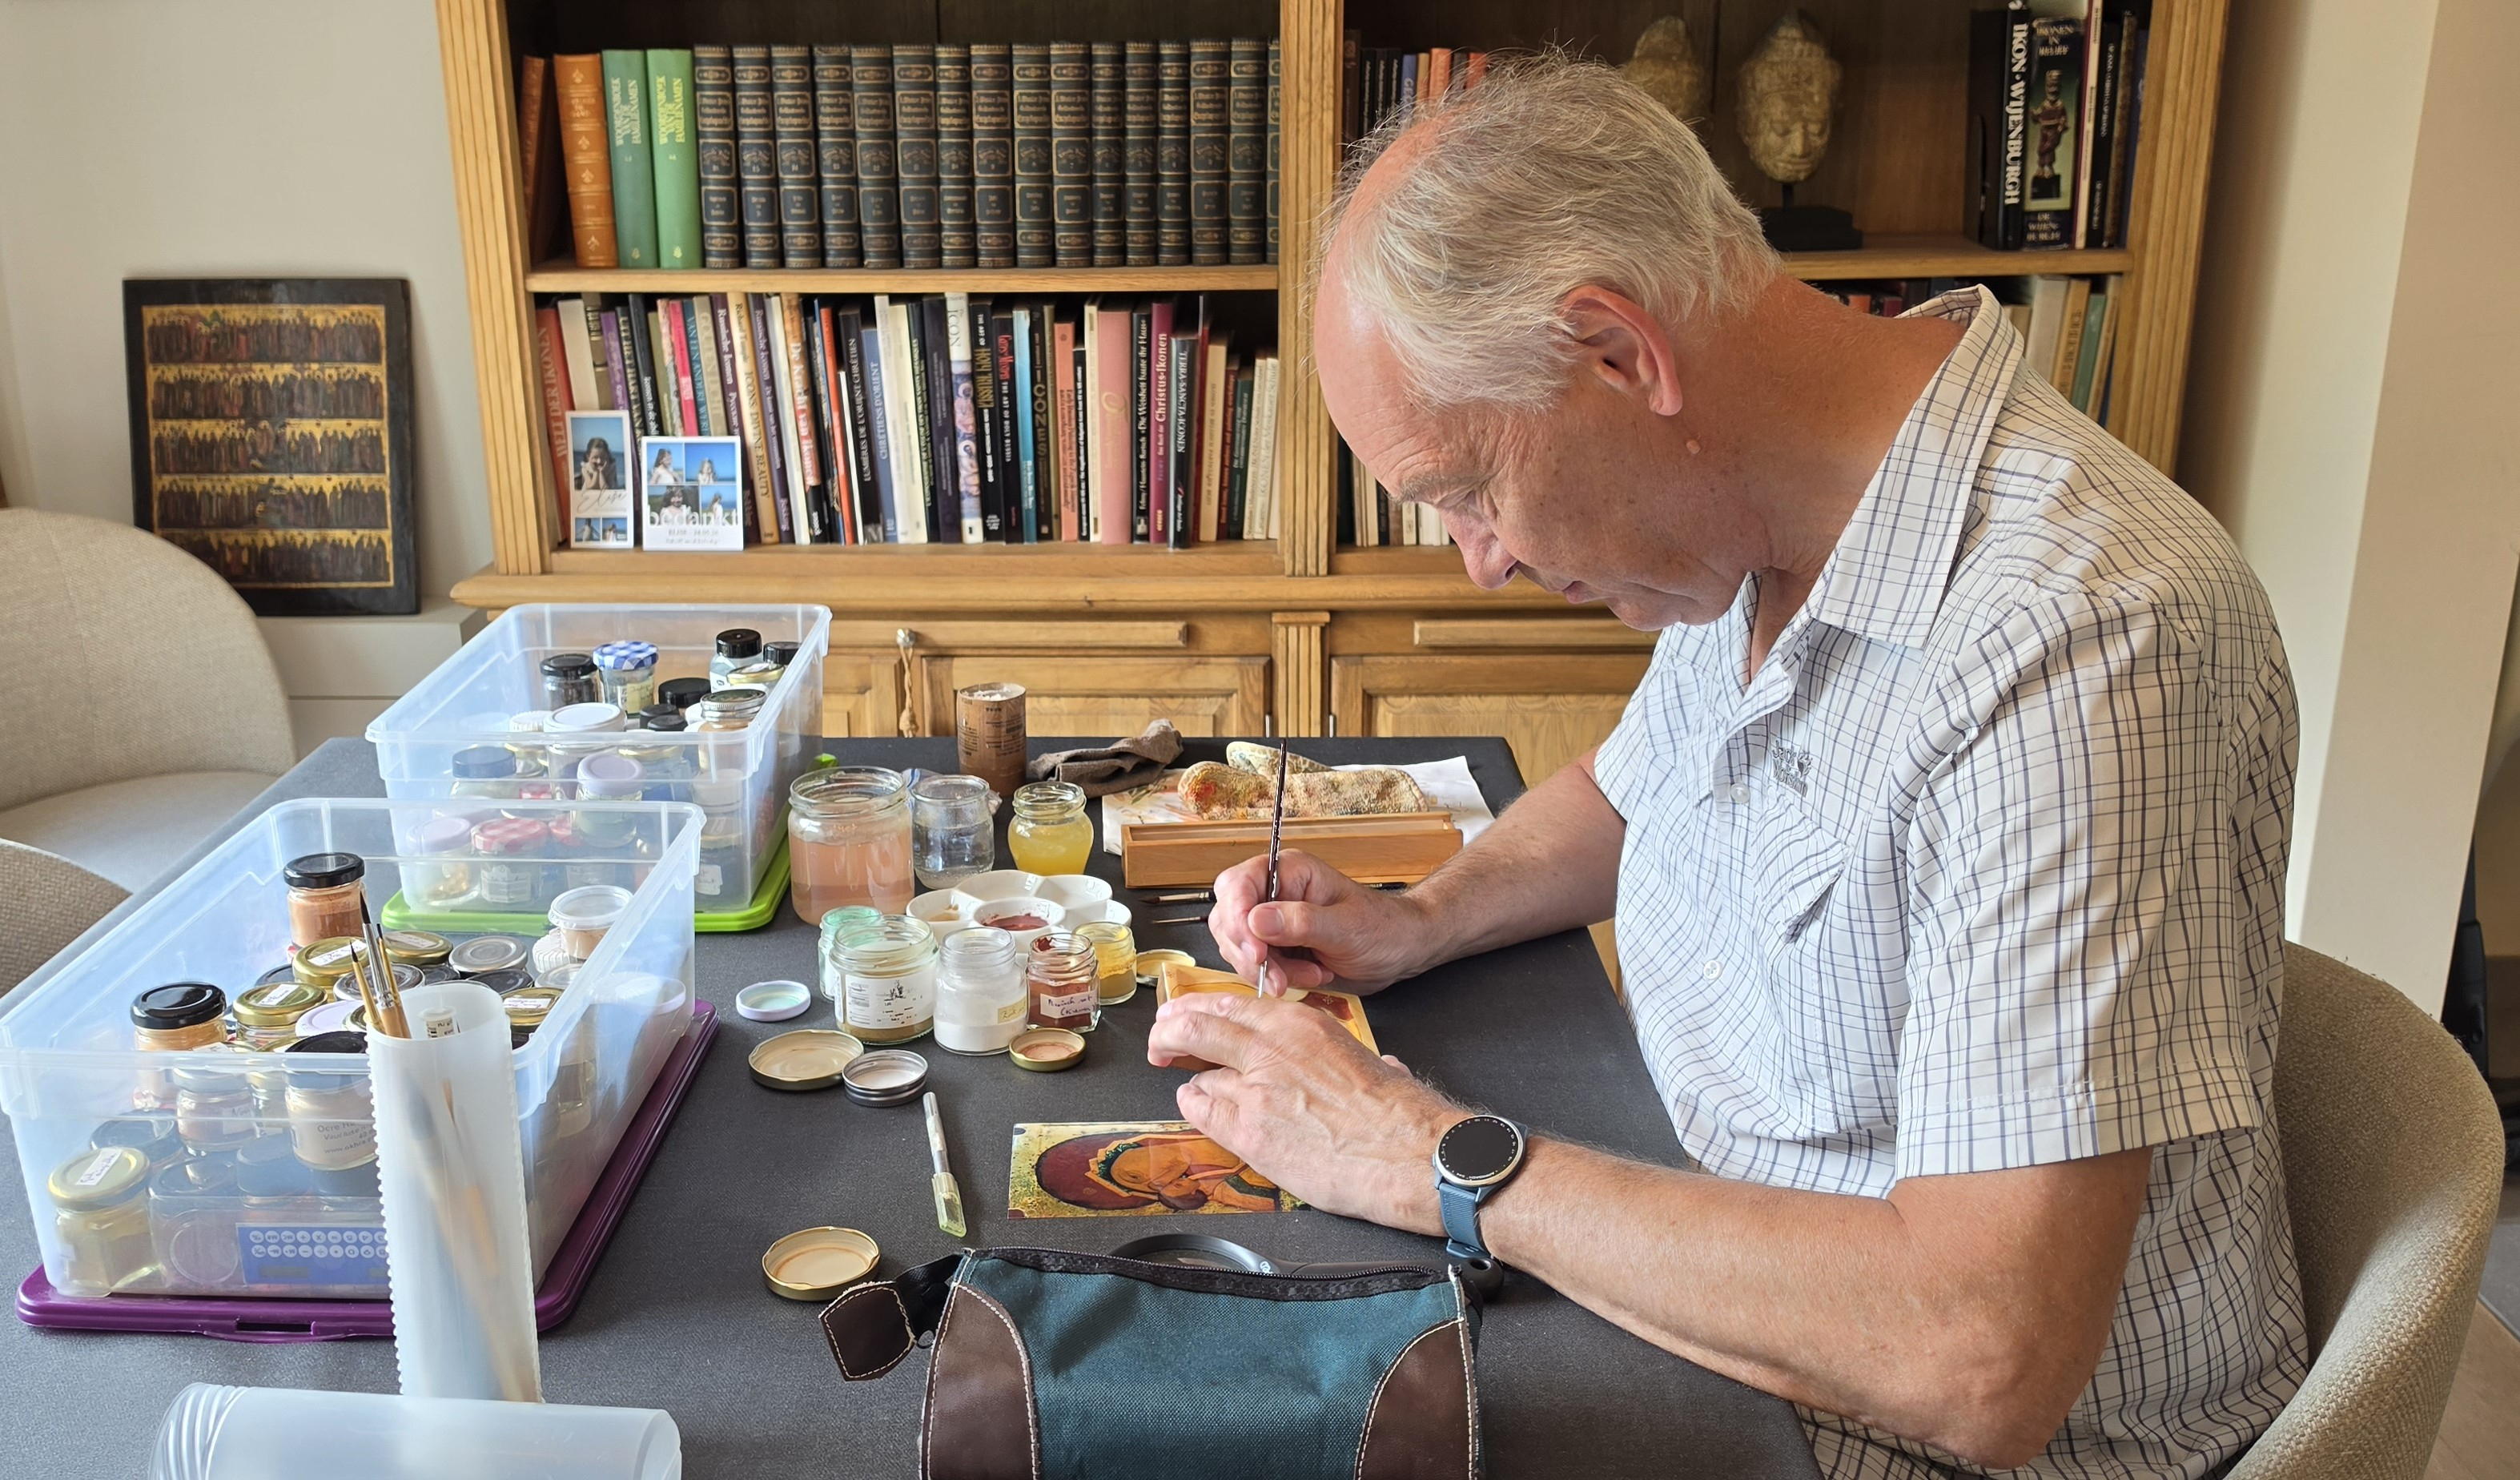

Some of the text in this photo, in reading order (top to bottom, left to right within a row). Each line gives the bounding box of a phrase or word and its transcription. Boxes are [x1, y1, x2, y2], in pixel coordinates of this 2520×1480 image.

[2011, 23, 2028, 72] IKON
[735, 303, 746, 333] Richard
[948, 309, 962, 348] ICON
[978, 314, 986, 324] THE
[537, 327, 556, 383] IKONEN
[979, 338, 986, 346] OF
[1139, 345, 1147, 358] ihr
[849, 338, 861, 384] CHRÉTIEN
[975, 348, 993, 371] HOLY
[1138, 359, 1147, 380] baute
[975, 373, 995, 408] RUSSIA
[1155, 333, 1168, 422] Christus-Ikonen
[548, 388, 562, 416] DER
[870, 360, 889, 460] CHRÉTIENS D'ORIENT
[1138, 380, 1147, 415] Weisheit
[790, 343, 814, 486] De Kracht van Ikonen
[550, 420, 568, 456] WELT
[750, 412, 763, 452] DIVINE
[858, 425, 867, 438] DE
[1004, 439, 1012, 462] RUSSIA
[756, 455, 770, 498] BEAUTY
[648, 504, 740, 528] bedankt
[317, 1124, 340, 1133] Ocre
[324, 1128, 360, 1140] Vaucluse
